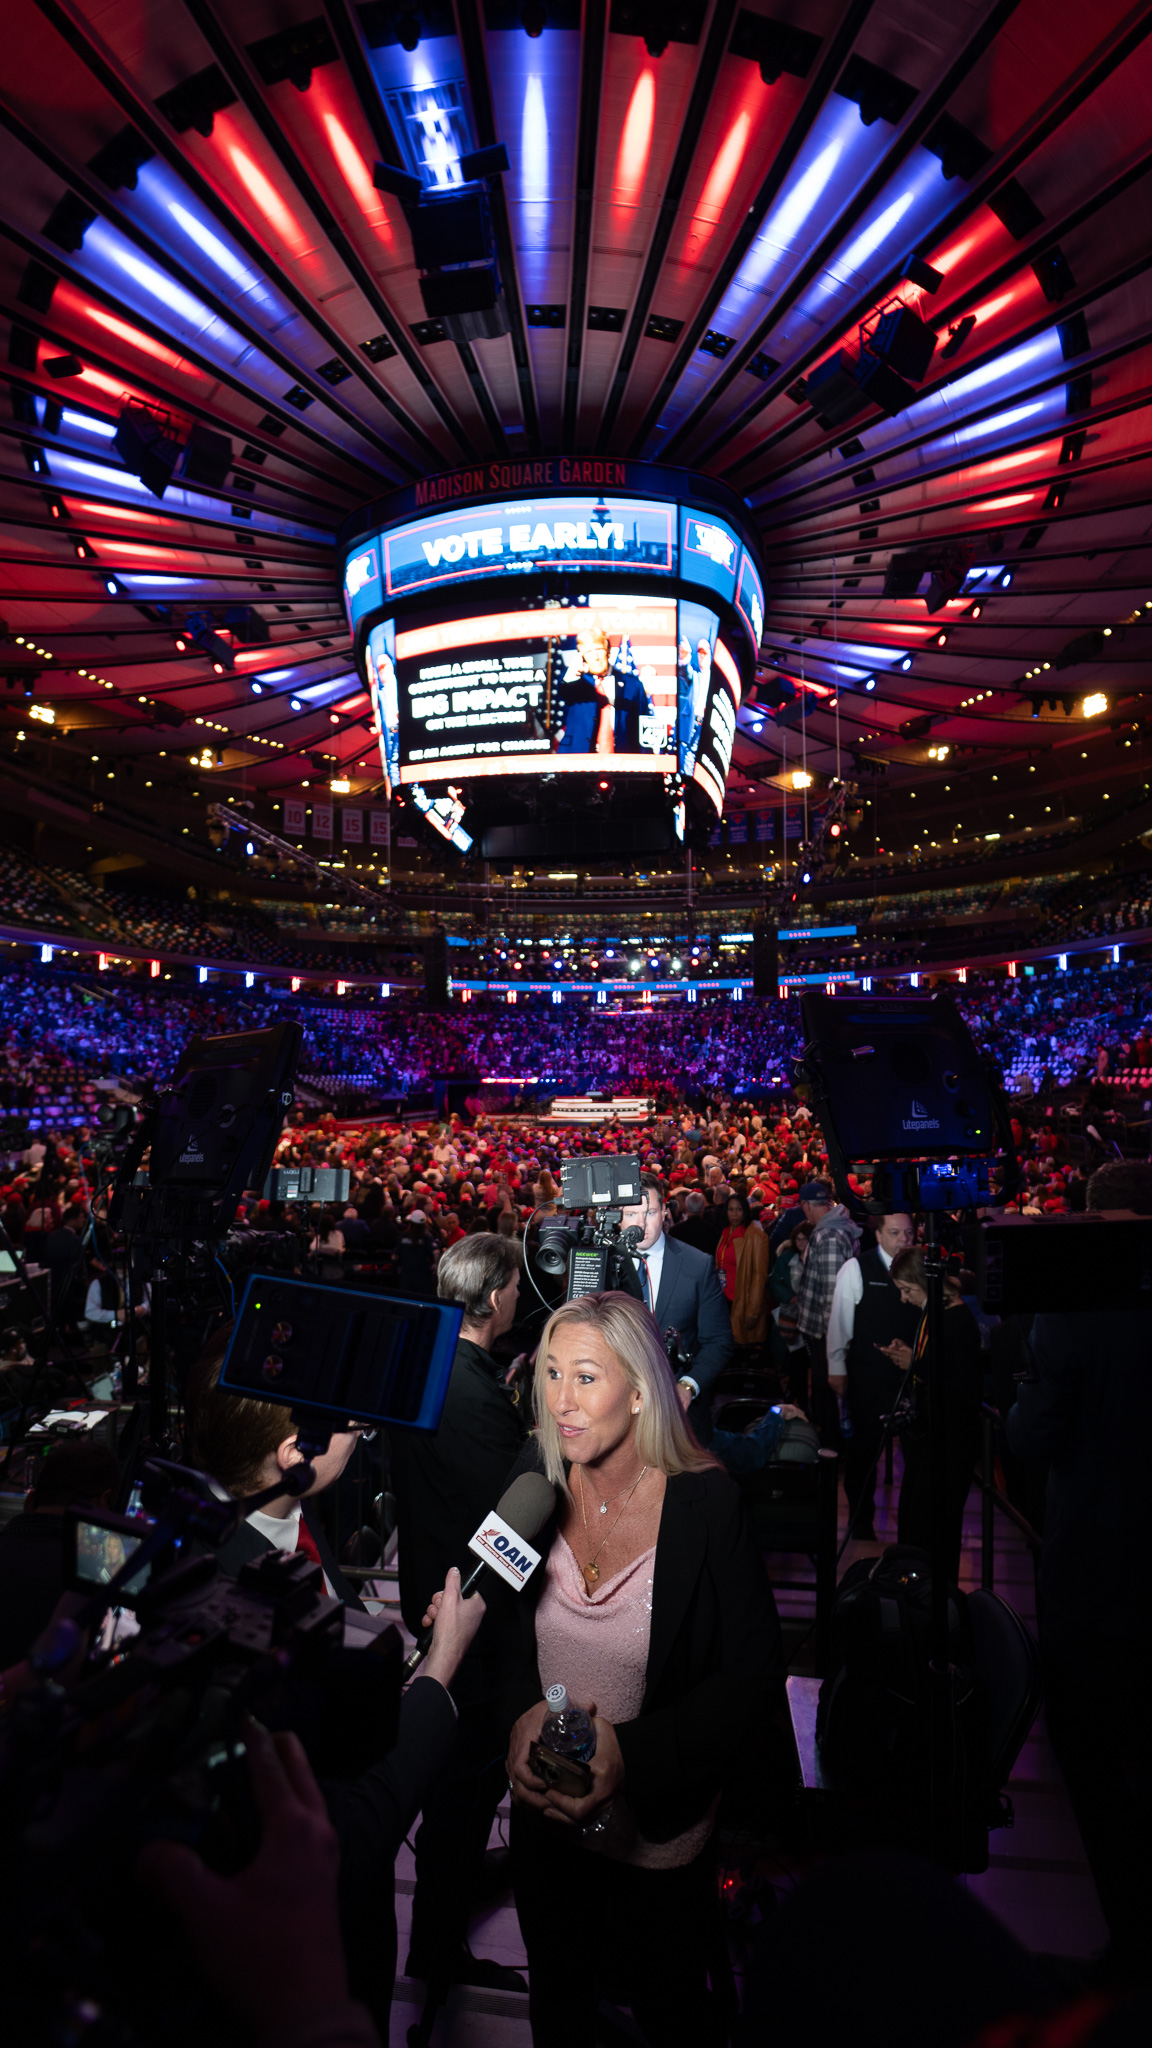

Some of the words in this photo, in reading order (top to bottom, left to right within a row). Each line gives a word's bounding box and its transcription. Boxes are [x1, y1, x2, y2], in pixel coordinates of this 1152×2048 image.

[415, 470, 484, 506] MADISON
[489, 462, 553, 489] SQUARE
[559, 459, 626, 484] GARDEN
[422, 527, 503, 567] VOTE
[509, 522, 624, 552] EARLY!
[438, 620, 501, 644] TRUMP
[503, 613, 569, 635] FORCE
[571, 612, 597, 630] 47
[598, 611, 668, 630] TODAY!
[412, 693, 449, 718] BIG
[452, 685, 544, 712] IMPACT
[288, 810, 302, 824] 10
[316, 814, 330, 828] 12
[345, 818, 359, 832] 15
[373, 821, 387, 834] 15
[902, 1118, 940, 1131] Litepanels
[494, 1535, 533, 1573] OAN
